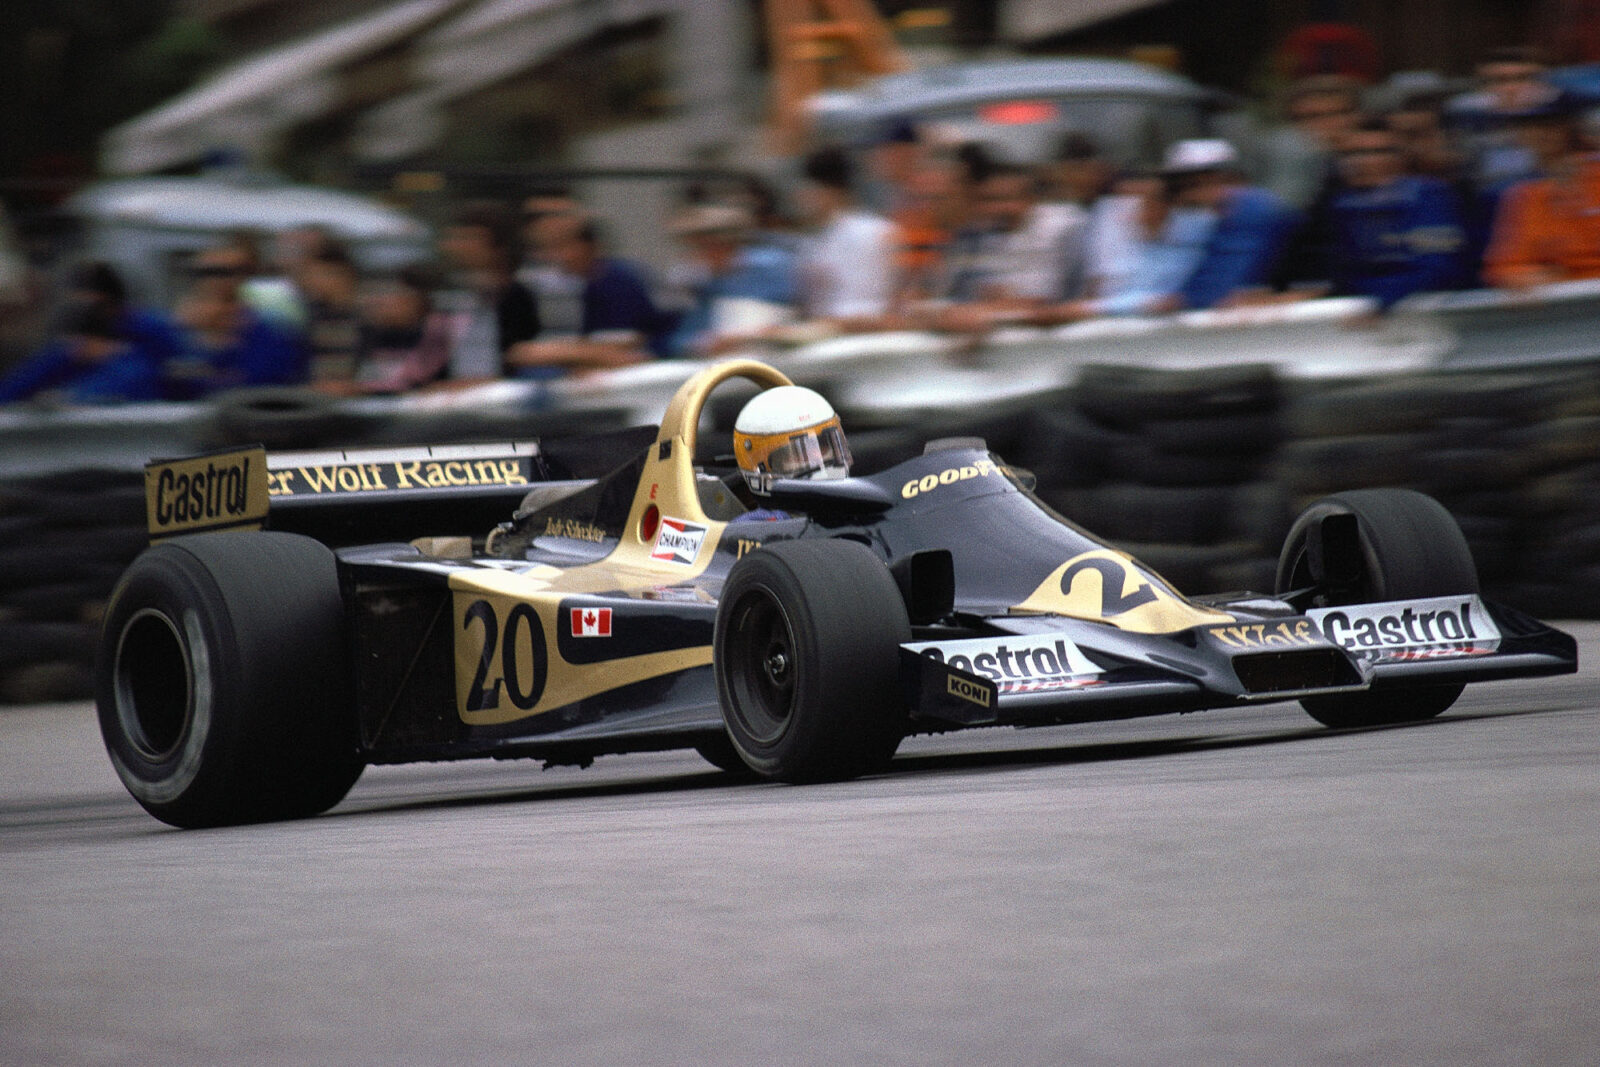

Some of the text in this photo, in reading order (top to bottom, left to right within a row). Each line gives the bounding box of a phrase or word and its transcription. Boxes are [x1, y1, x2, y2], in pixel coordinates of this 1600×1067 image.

[157, 458, 249, 526] Castrol
[298, 464, 388, 494] Wolf
[397, 459, 528, 488] Racing
[659, 533, 697, 552] CHAMPION
[1323, 603, 1477, 648] Castrol
[464, 600, 548, 711] 20
[950, 678, 989, 701] KONI
